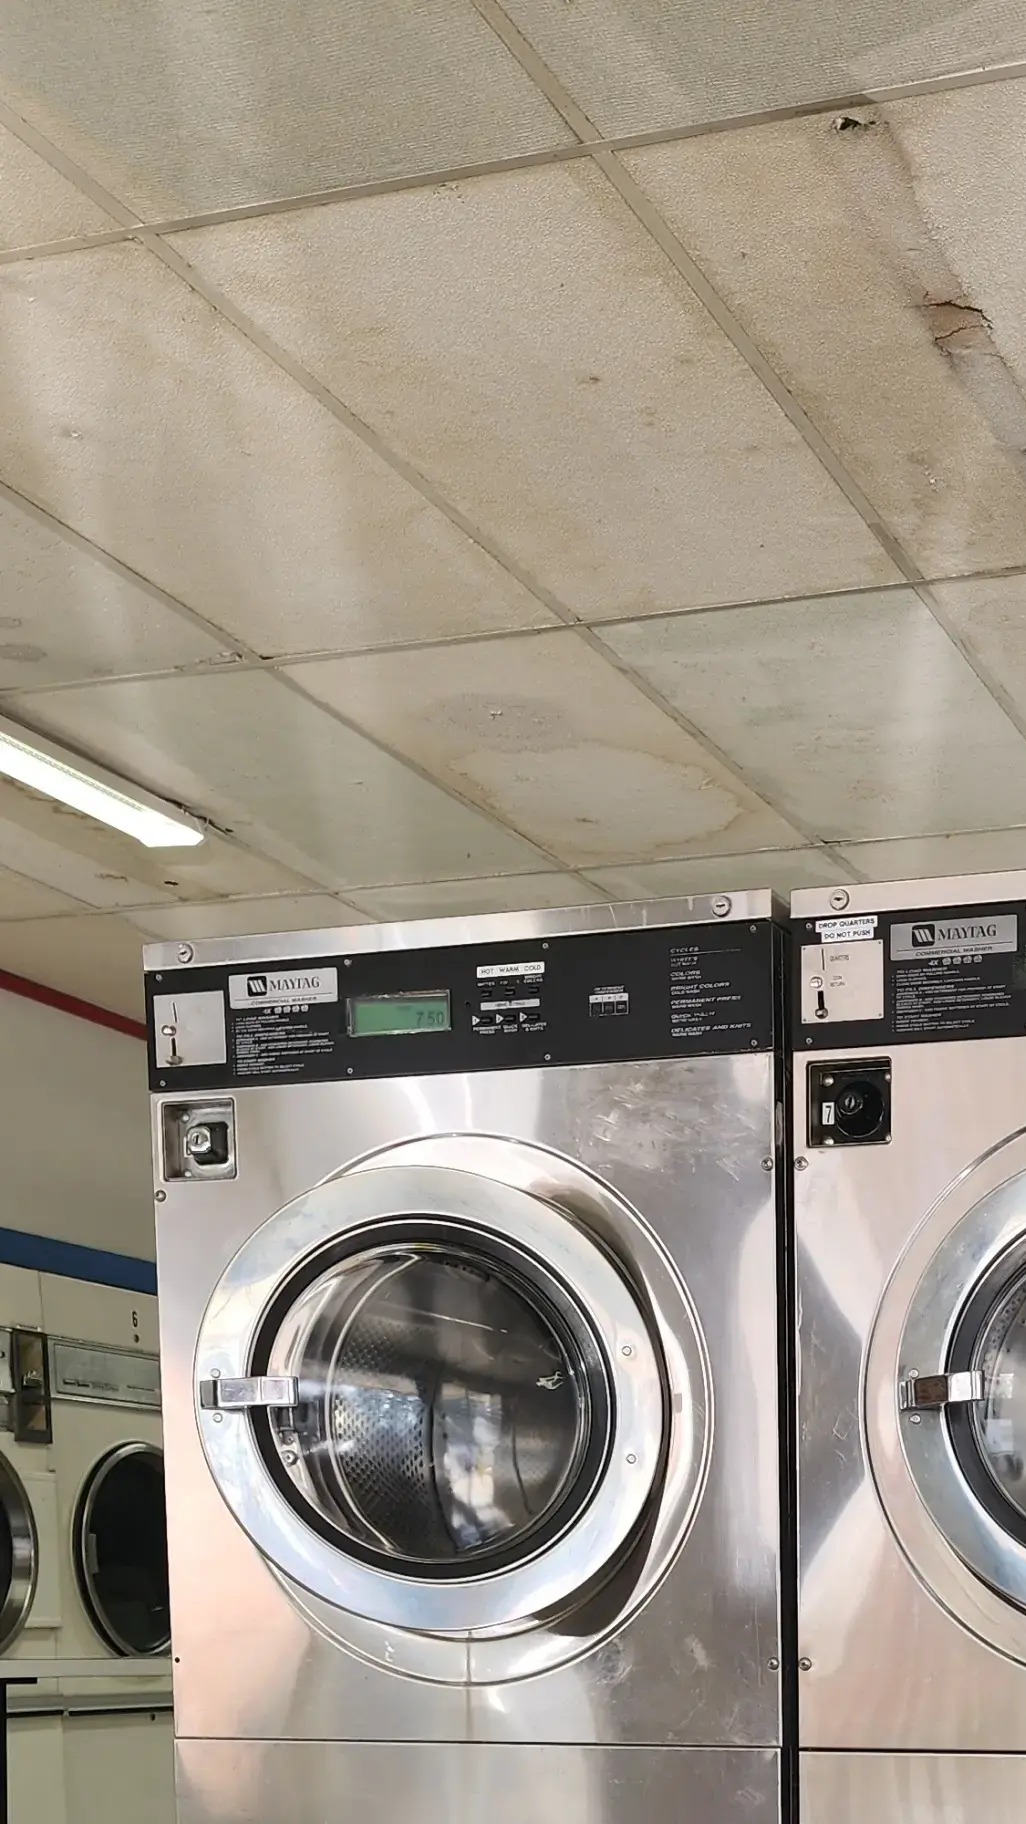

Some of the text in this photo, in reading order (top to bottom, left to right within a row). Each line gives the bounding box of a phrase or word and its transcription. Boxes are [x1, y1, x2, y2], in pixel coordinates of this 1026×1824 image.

[818, 918, 875, 930] DROP QUARTERS
[824, 929, 871, 939] DO NOT PUSH
[937, 924, 997, 941] MAYTAG
[914, 948, 962, 957] COMMERCIAL
[524, 964, 542, 972] COLD
[270, 976, 320, 992] MAYTAG
[825, 1105, 832, 1124] 7
[132, 1310, 138, 1328] 6
